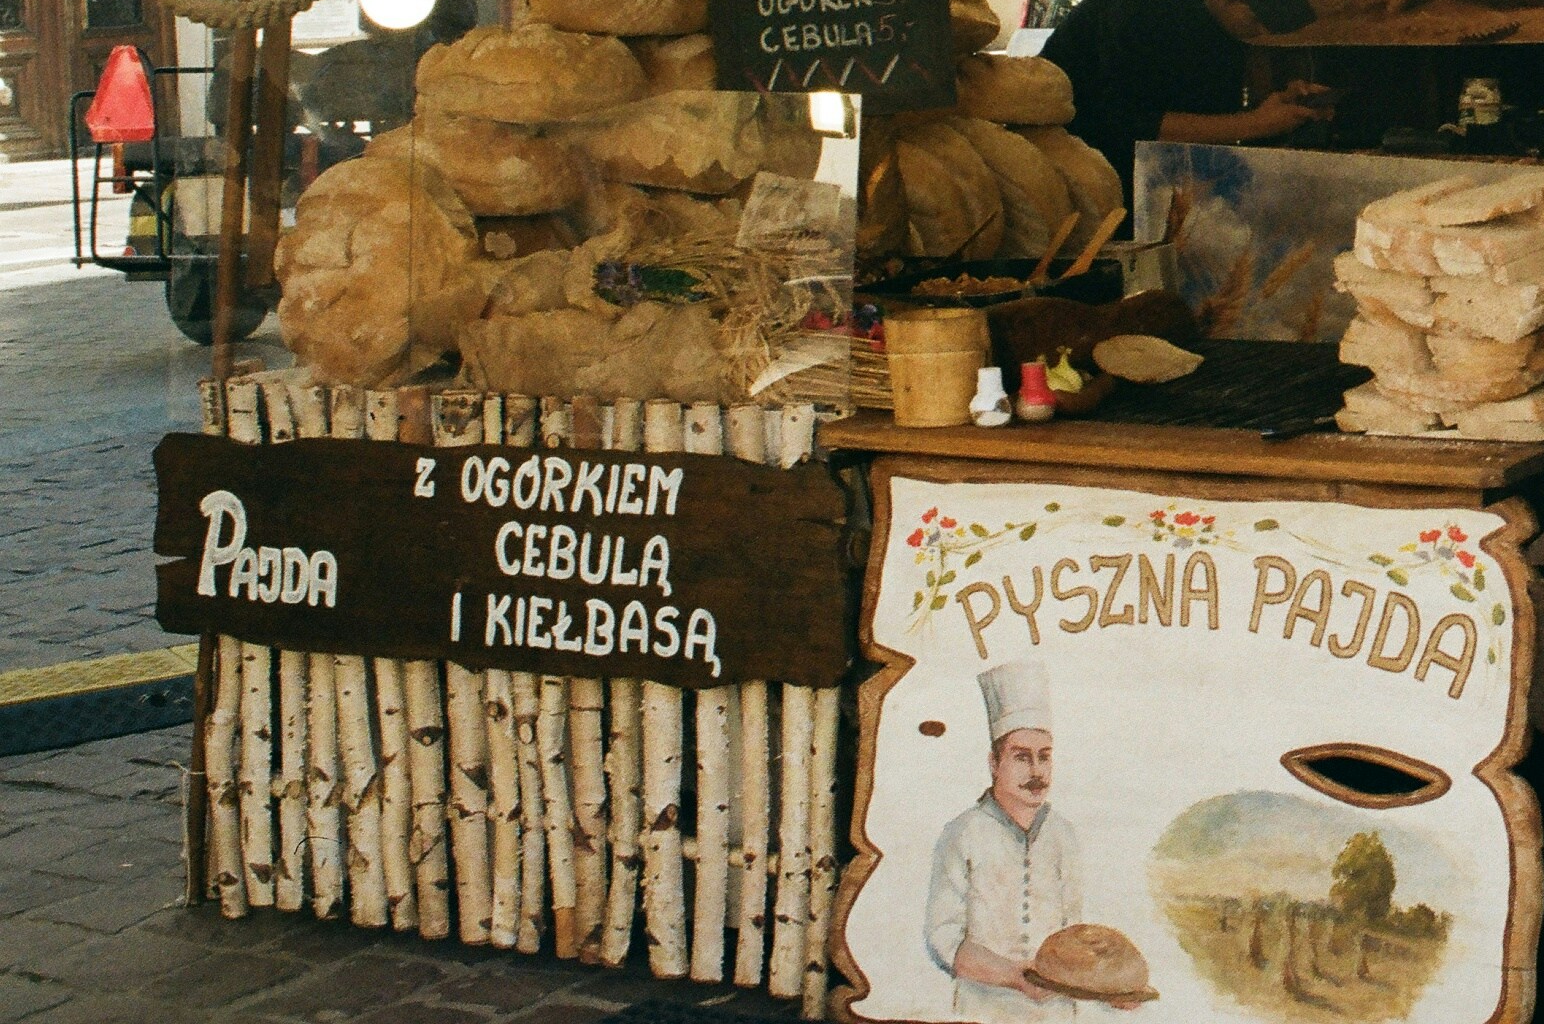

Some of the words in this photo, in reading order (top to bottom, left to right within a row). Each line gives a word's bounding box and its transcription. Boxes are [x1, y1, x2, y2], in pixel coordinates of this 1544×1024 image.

[760, 22, 873, 53] CEBULA
[413, 457, 436, 498] Z
[460, 454, 684, 516] OGÓRKIEM
[495, 520, 672, 597] CEBULĄ
[450, 592, 462, 642] I
[484, 593, 722, 678] KIEŁBASĄ
[955, 551, 1220, 660] PYSZNA
[1248, 555, 1479, 701] PAJDA
